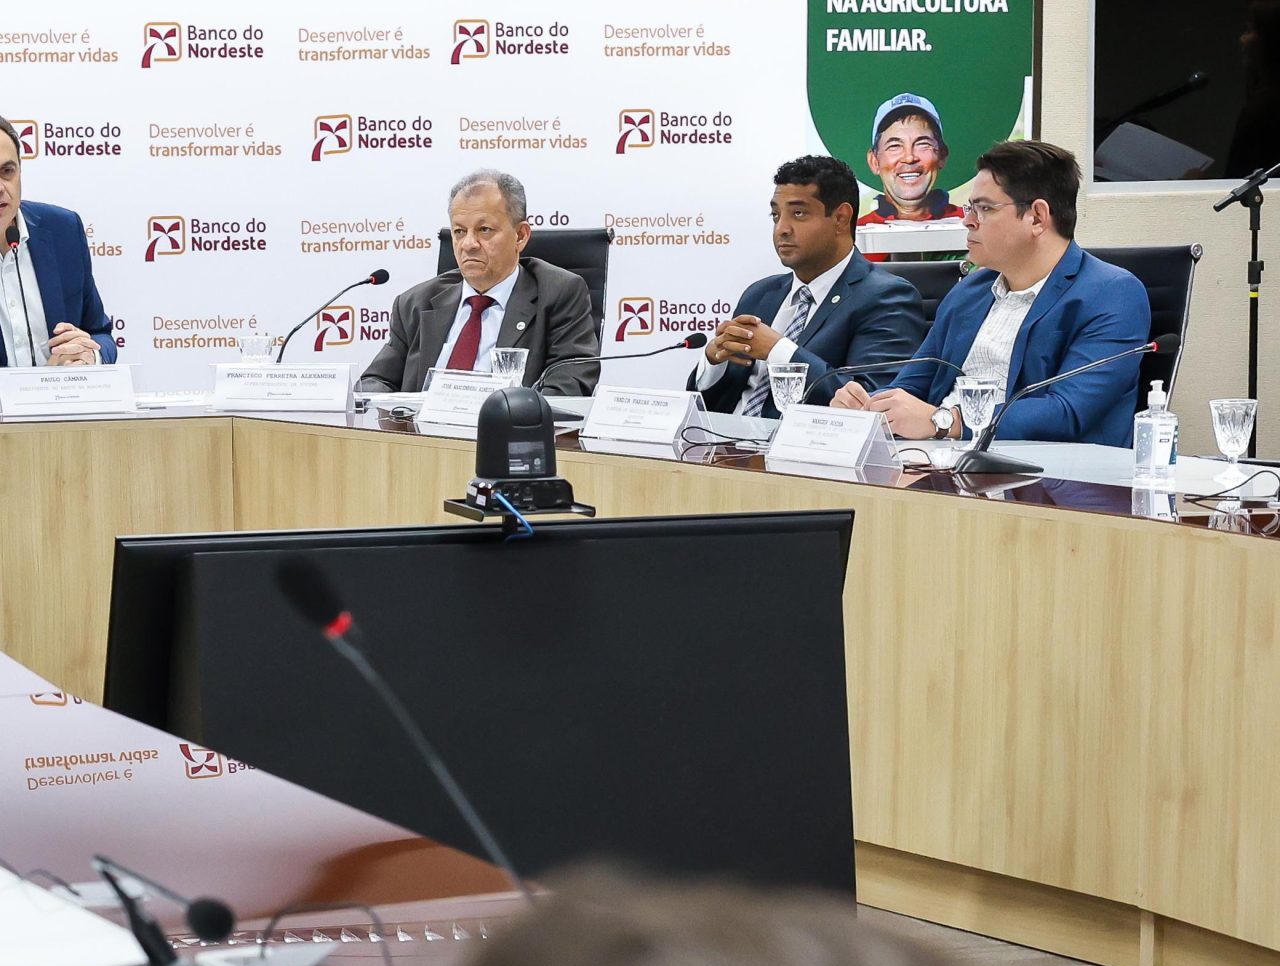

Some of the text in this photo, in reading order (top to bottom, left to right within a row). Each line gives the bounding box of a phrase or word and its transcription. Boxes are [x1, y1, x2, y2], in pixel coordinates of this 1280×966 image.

[826, 0, 858, 13] NA
[81, 29, 90, 43] é
[188, 25, 263, 40] Banco do
[299, 27, 403, 43] Desenvolver é
[496, 22, 568, 37] Banco do
[605, 24, 704, 39] Desenvolver é
[496, 40, 568, 54] Nordeste
[826, 28, 932, 51] FAMILIAR.
[78, 48, 118, 62] vidas
[188, 43, 263, 58] Nordeste
[299, 45, 430, 61] transformar vidas
[604, 42, 730, 56] transformar vidas
[358, 116, 432, 131] Banco do
[460, 117, 560, 131] Desenvolver é
[661, 112, 732, 127] Banco do
[45, 122, 121, 138] Banco do
[150, 123, 254, 138] Desenvolver é
[661, 129, 732, 144] Nordeste
[45, 141, 121, 156] Nordeste
[359, 134, 432, 148] Nordeste
[459, 134, 587, 149] transformar vidas
[150, 141, 281, 157] transformar vidas
[191, 218, 266, 233] Banco do
[301, 217, 404, 234] Desenvolver é
[550, 211, 569, 225] do
[605, 213, 704, 228] Desenvolver é
[192, 236, 266, 251] Nordeste
[301, 235, 431, 252] transformar vidas
[613, 231, 729, 246] ansformar vidas
[660, 299, 731, 314] Banco do
[153, 315, 257, 330] Desenvolver é
[361, 308, 390, 323] Ban
[660, 317, 721, 331] Nordest
